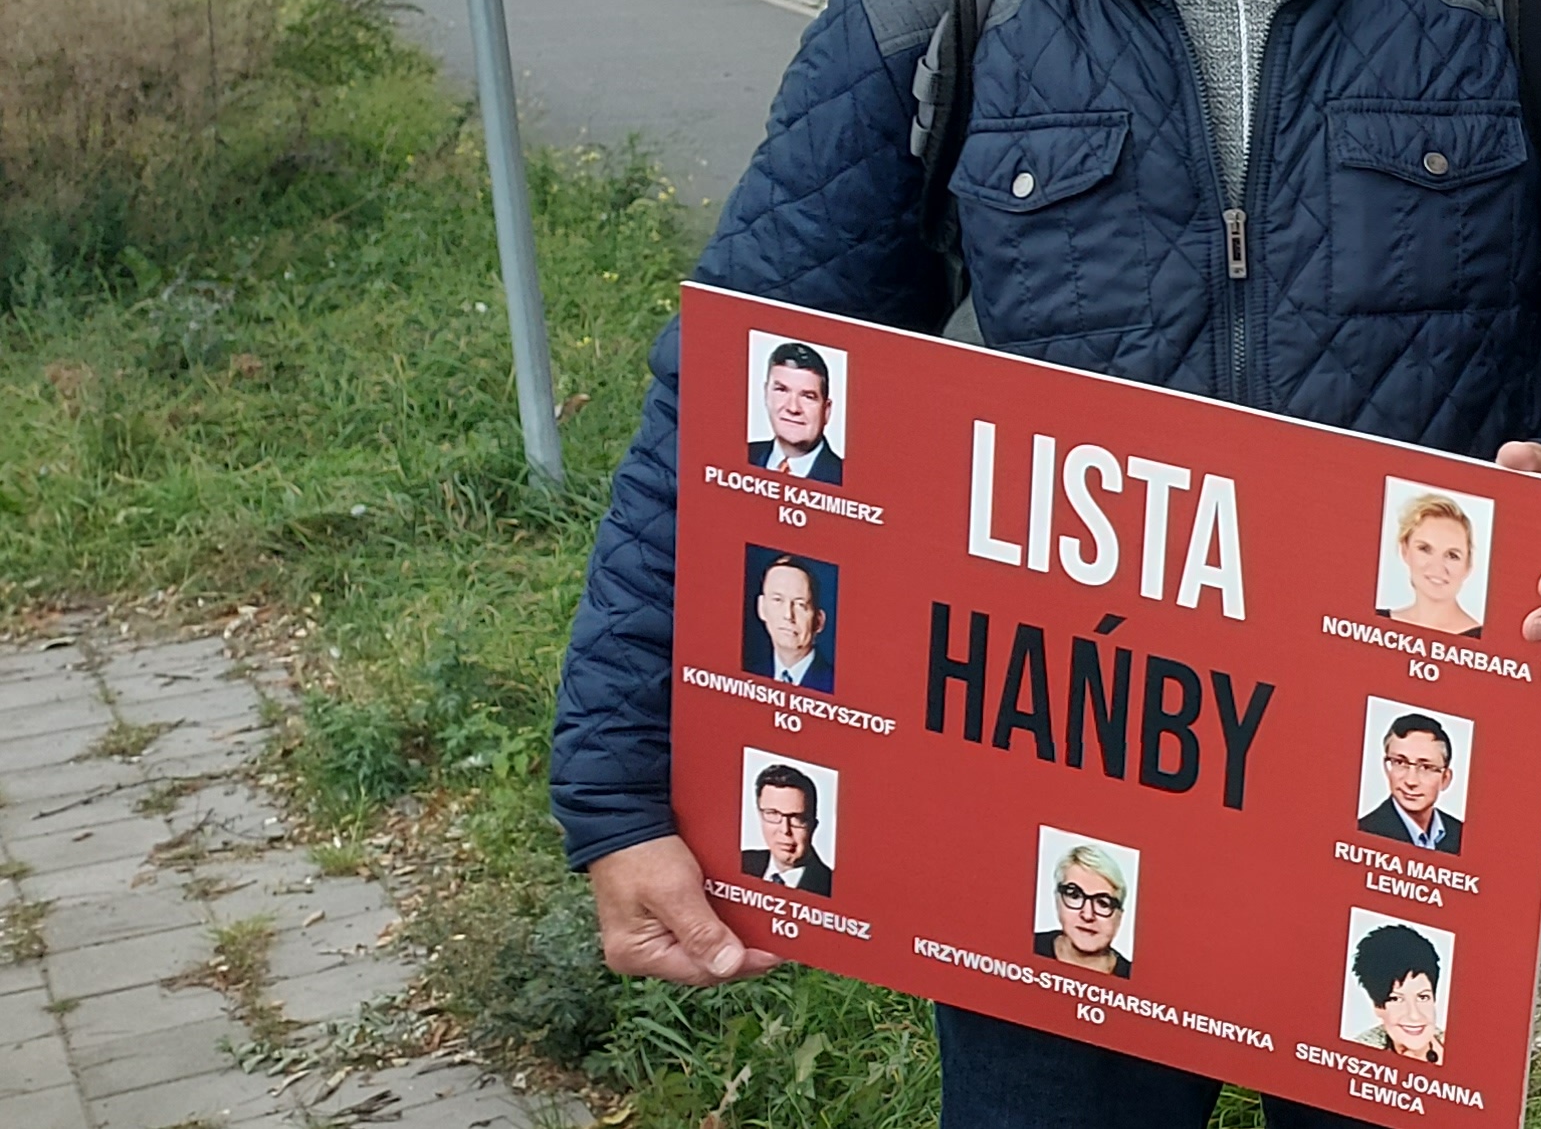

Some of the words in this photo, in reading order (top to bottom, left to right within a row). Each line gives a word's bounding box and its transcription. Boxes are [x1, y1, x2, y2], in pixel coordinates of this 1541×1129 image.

[704, 465, 781, 500] PLOCKE
[783, 484, 885, 525] KAZIMIERZ
[778, 505, 808, 527] KO
[968, 419, 1246, 621] LISTA
[1322, 615, 1427, 657] NOWACKA
[1430, 641, 1533, 682] BARBARA
[1408, 659, 1441, 682] KO
[682, 666, 786, 708] KONWIŃSKI
[789, 693, 896, 735] KRZYSZTOF
[774, 711, 802, 732] KO
[925, 600, 1276, 811] HAŃBY
[1334, 841, 1403, 874] RUTKA
[1406, 859, 1480, 894] MAREK
[1365, 871, 1444, 908] LEWICA
[703, 878, 788, 916] AZIEWICZ
[788, 901, 872, 940] TADEUSZ
[771, 917, 799, 939] KO
[913, 936, 1179, 1026] KRZYWONOS-STRYCHARSKA
[1181, 1010, 1275, 1053] HENRYKA
[1076, 1003, 1106, 1025] KO
[1294, 1042, 1399, 1086] SENYSZYN
[1401, 1072, 1485, 1110] JOANNA
[1348, 1077, 1426, 1116] LEWICA
